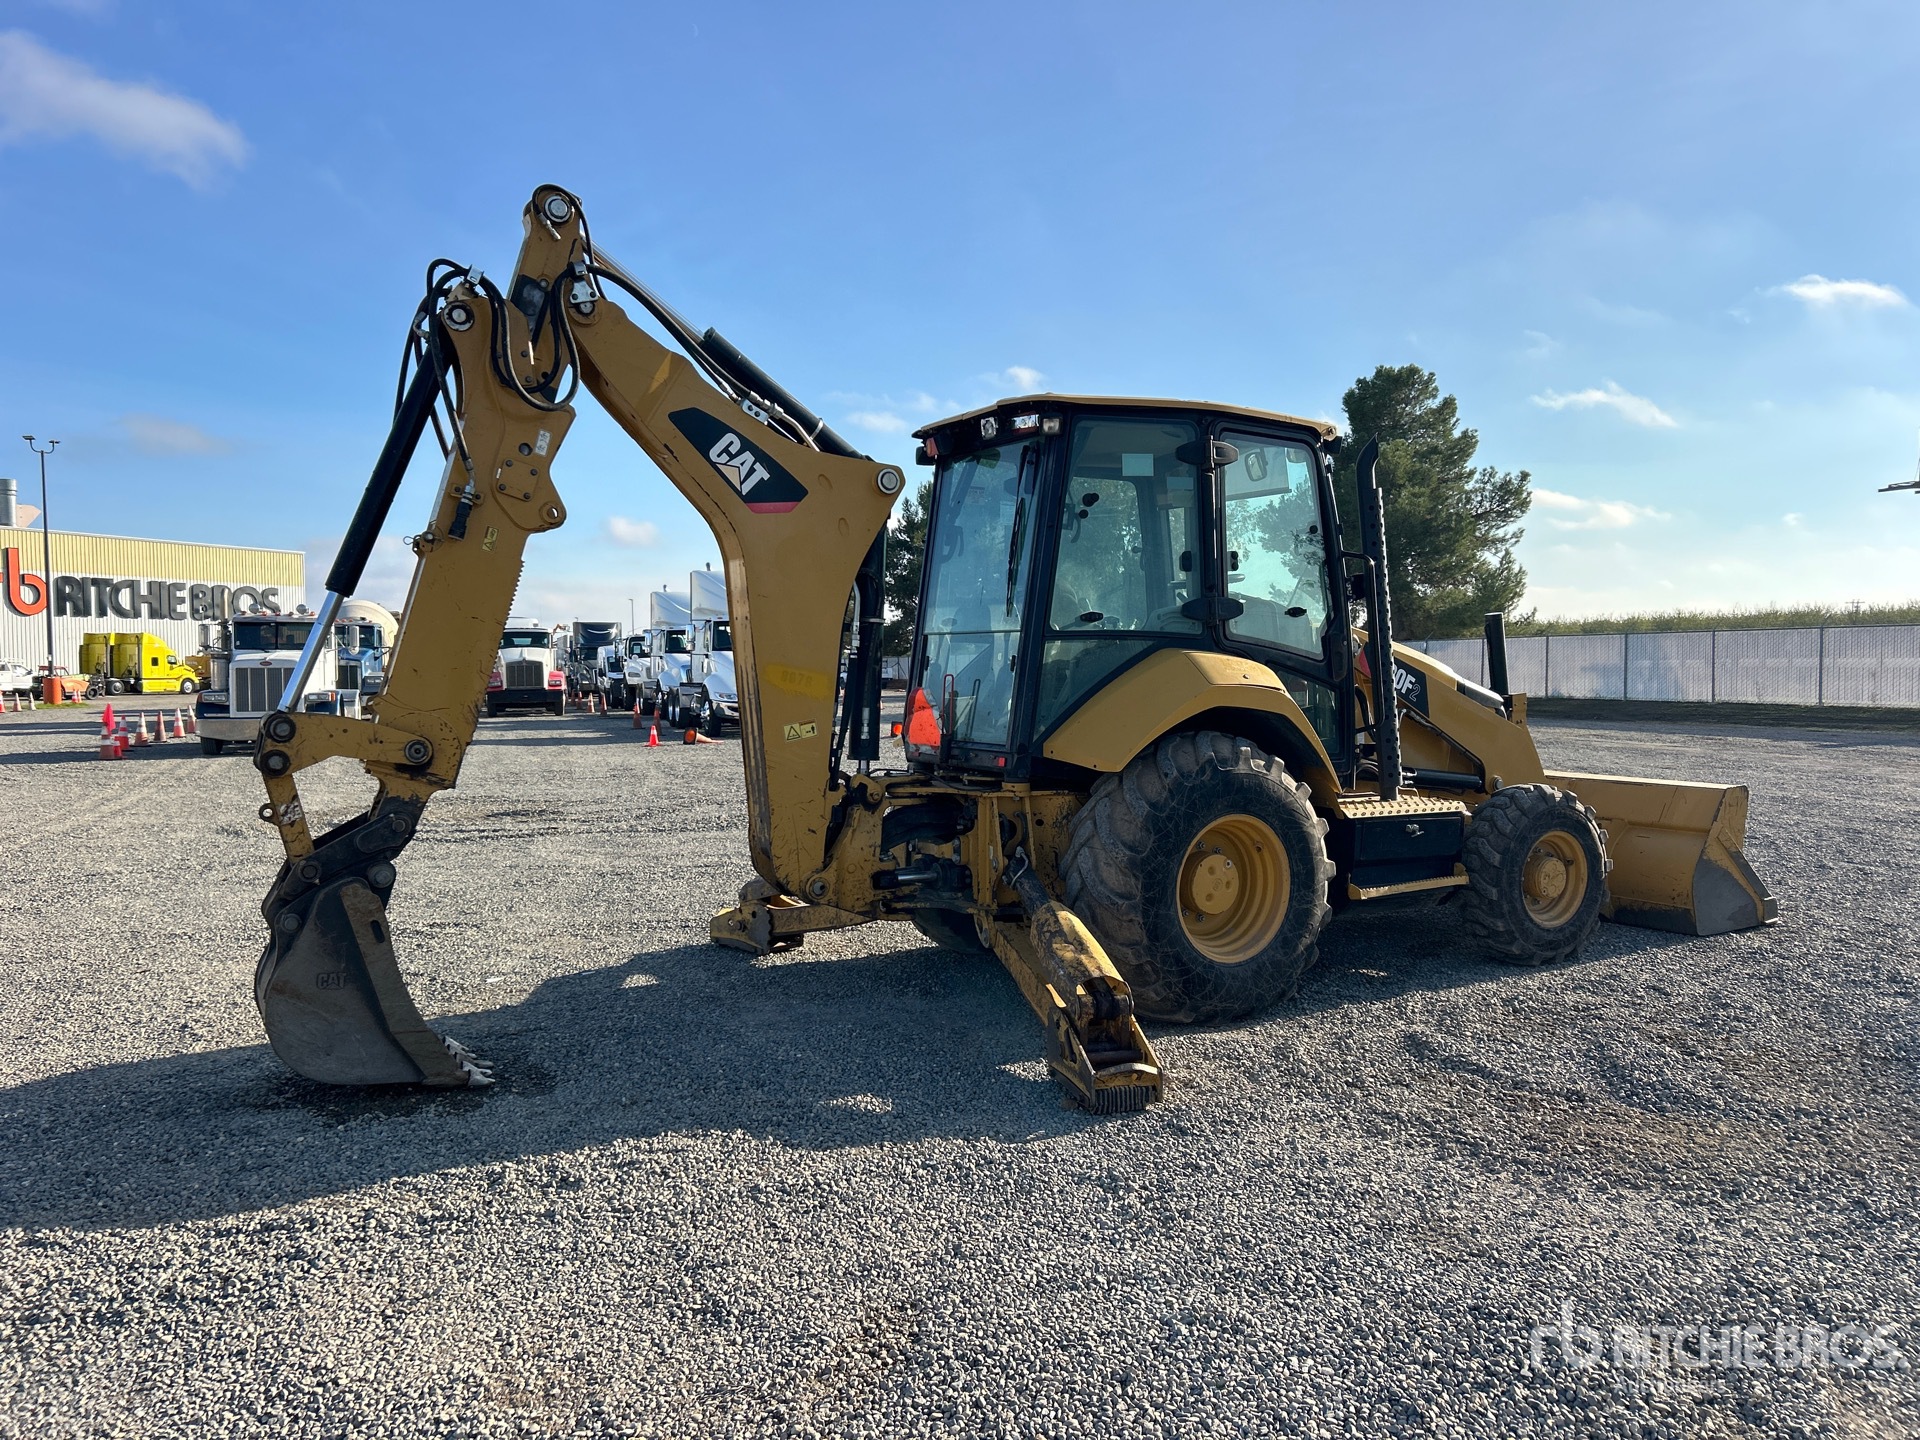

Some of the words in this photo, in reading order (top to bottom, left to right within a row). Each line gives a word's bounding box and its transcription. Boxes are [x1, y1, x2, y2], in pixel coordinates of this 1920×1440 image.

[709, 432, 771, 496] CAT
[53, 575, 187, 620] RITCHIE
[189, 583, 281, 621] BROS
[316, 972, 348, 990] CAT
